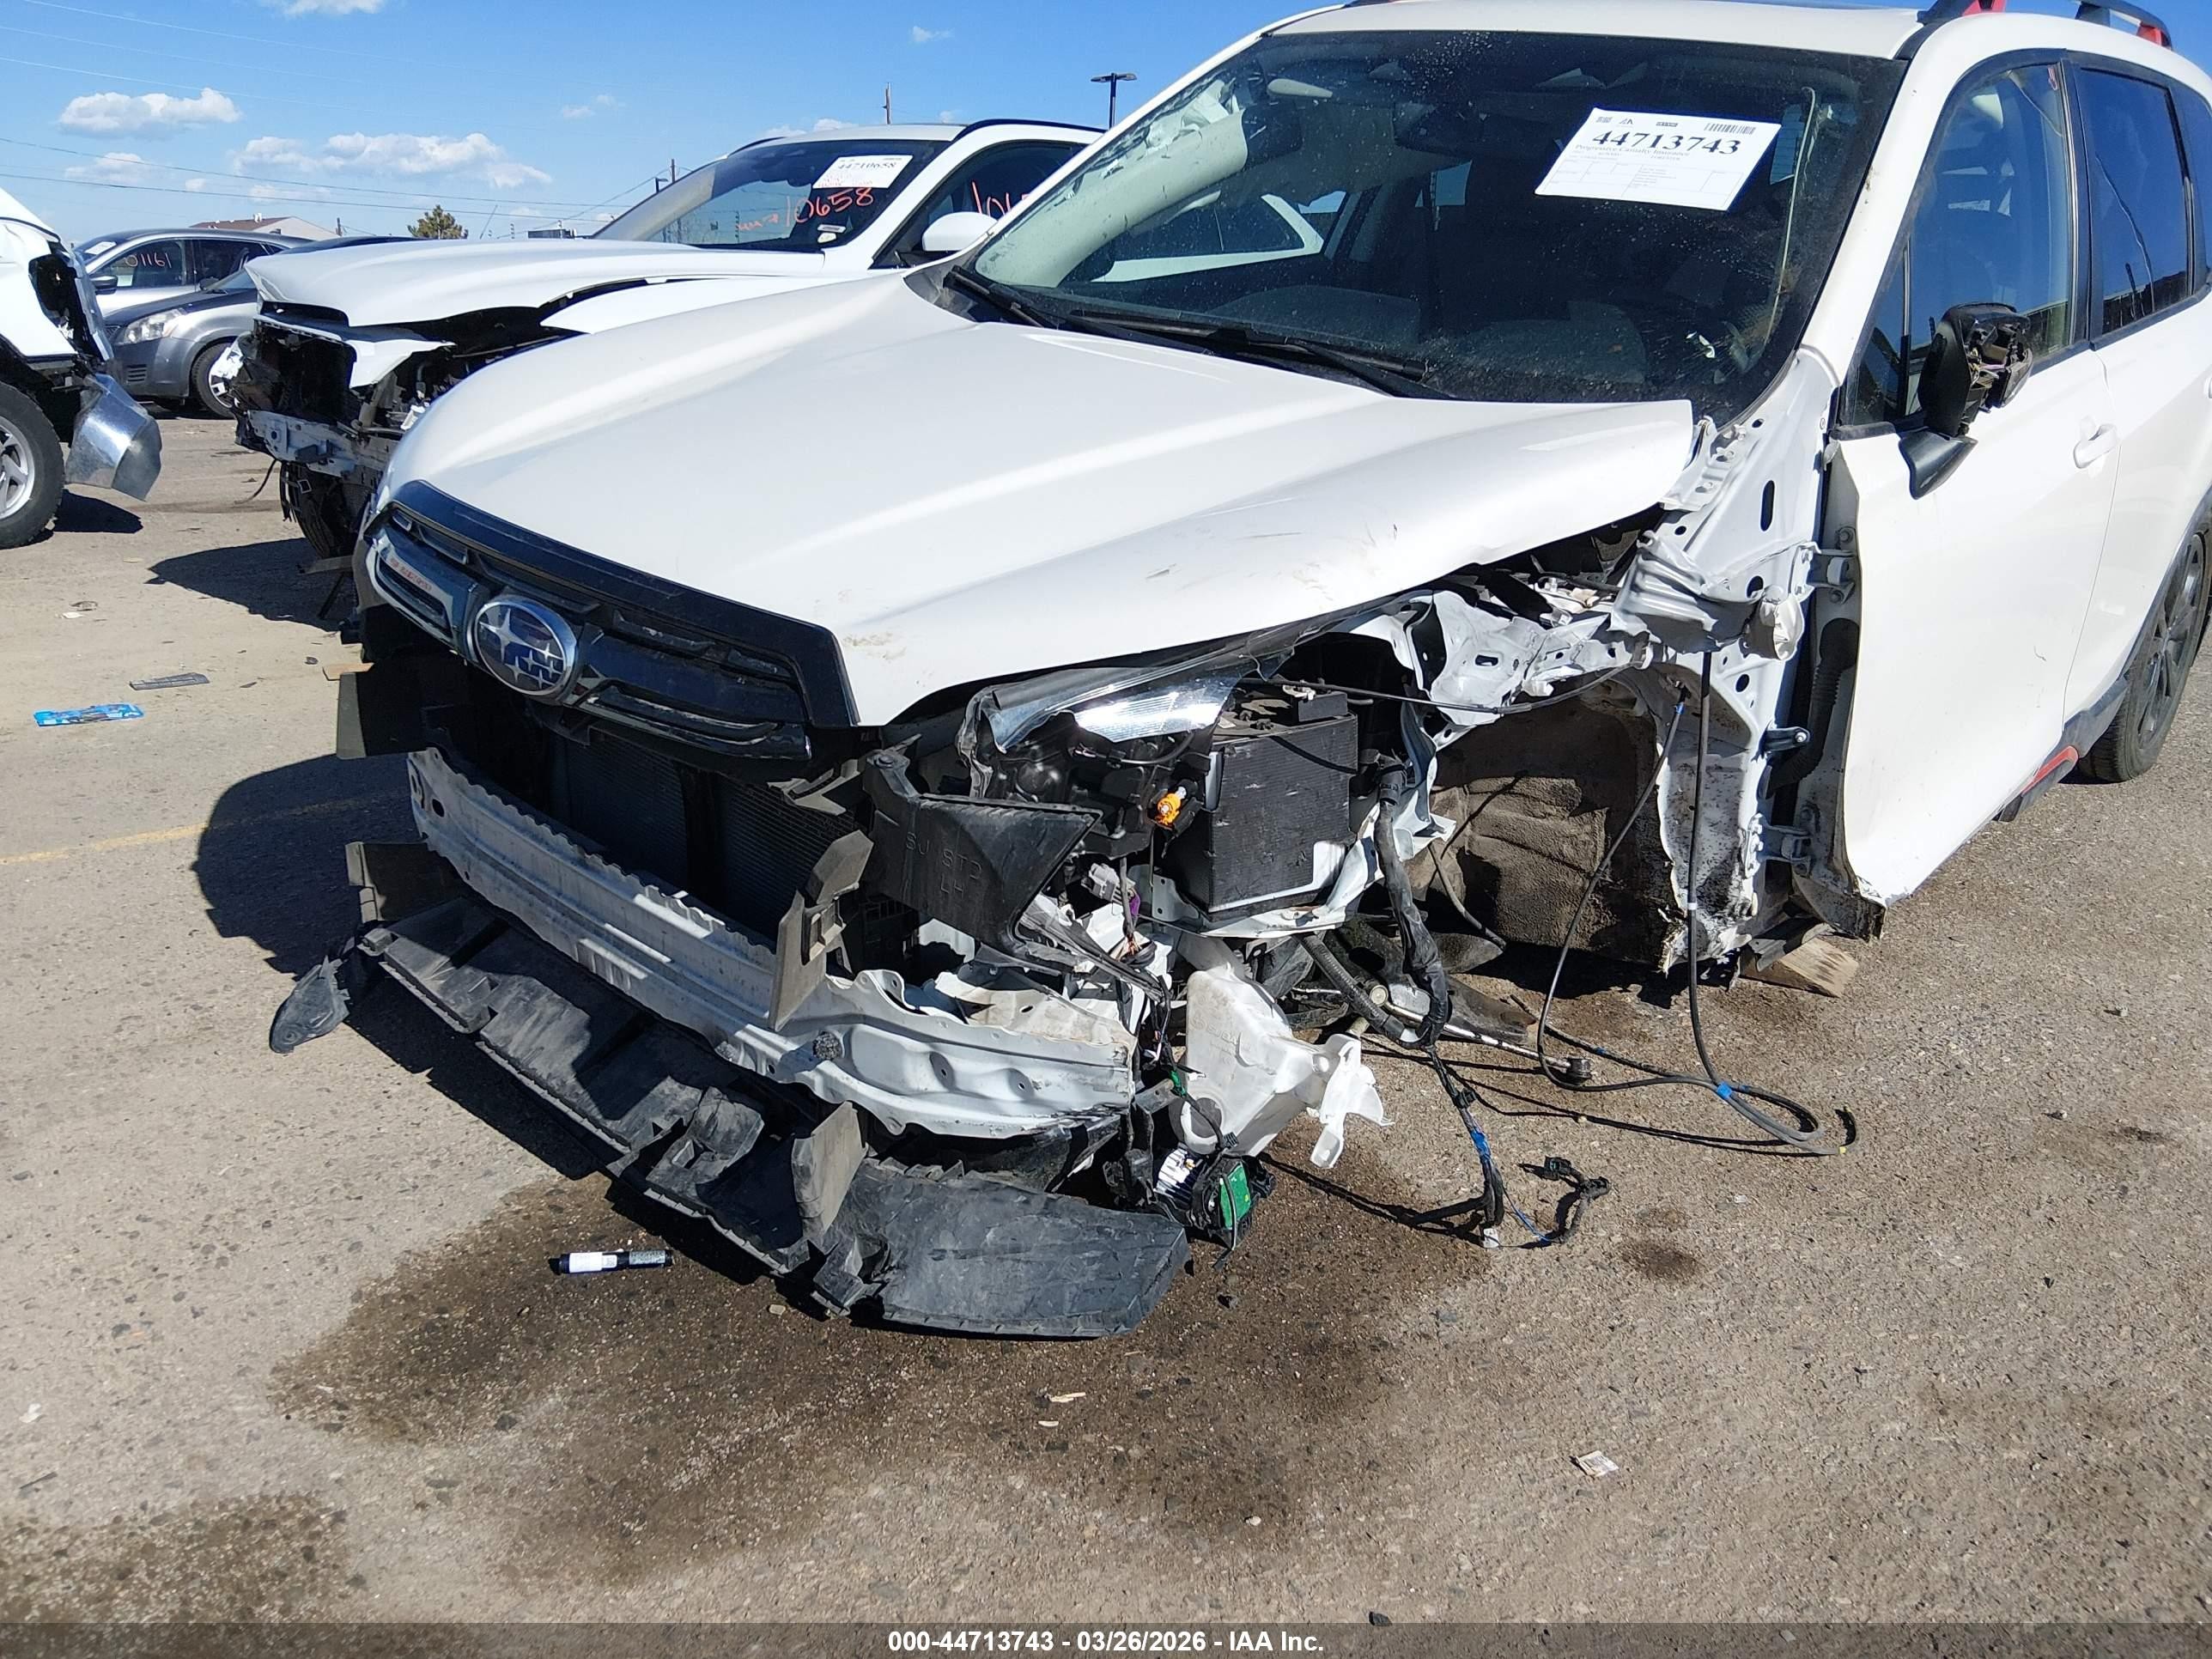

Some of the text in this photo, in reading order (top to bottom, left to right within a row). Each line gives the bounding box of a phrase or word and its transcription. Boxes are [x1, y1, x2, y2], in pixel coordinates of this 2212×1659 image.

[1592, 130, 1741, 155] 44713743
[786, 187, 874, 227] 10658
[125, 252, 172, 268] 01161
